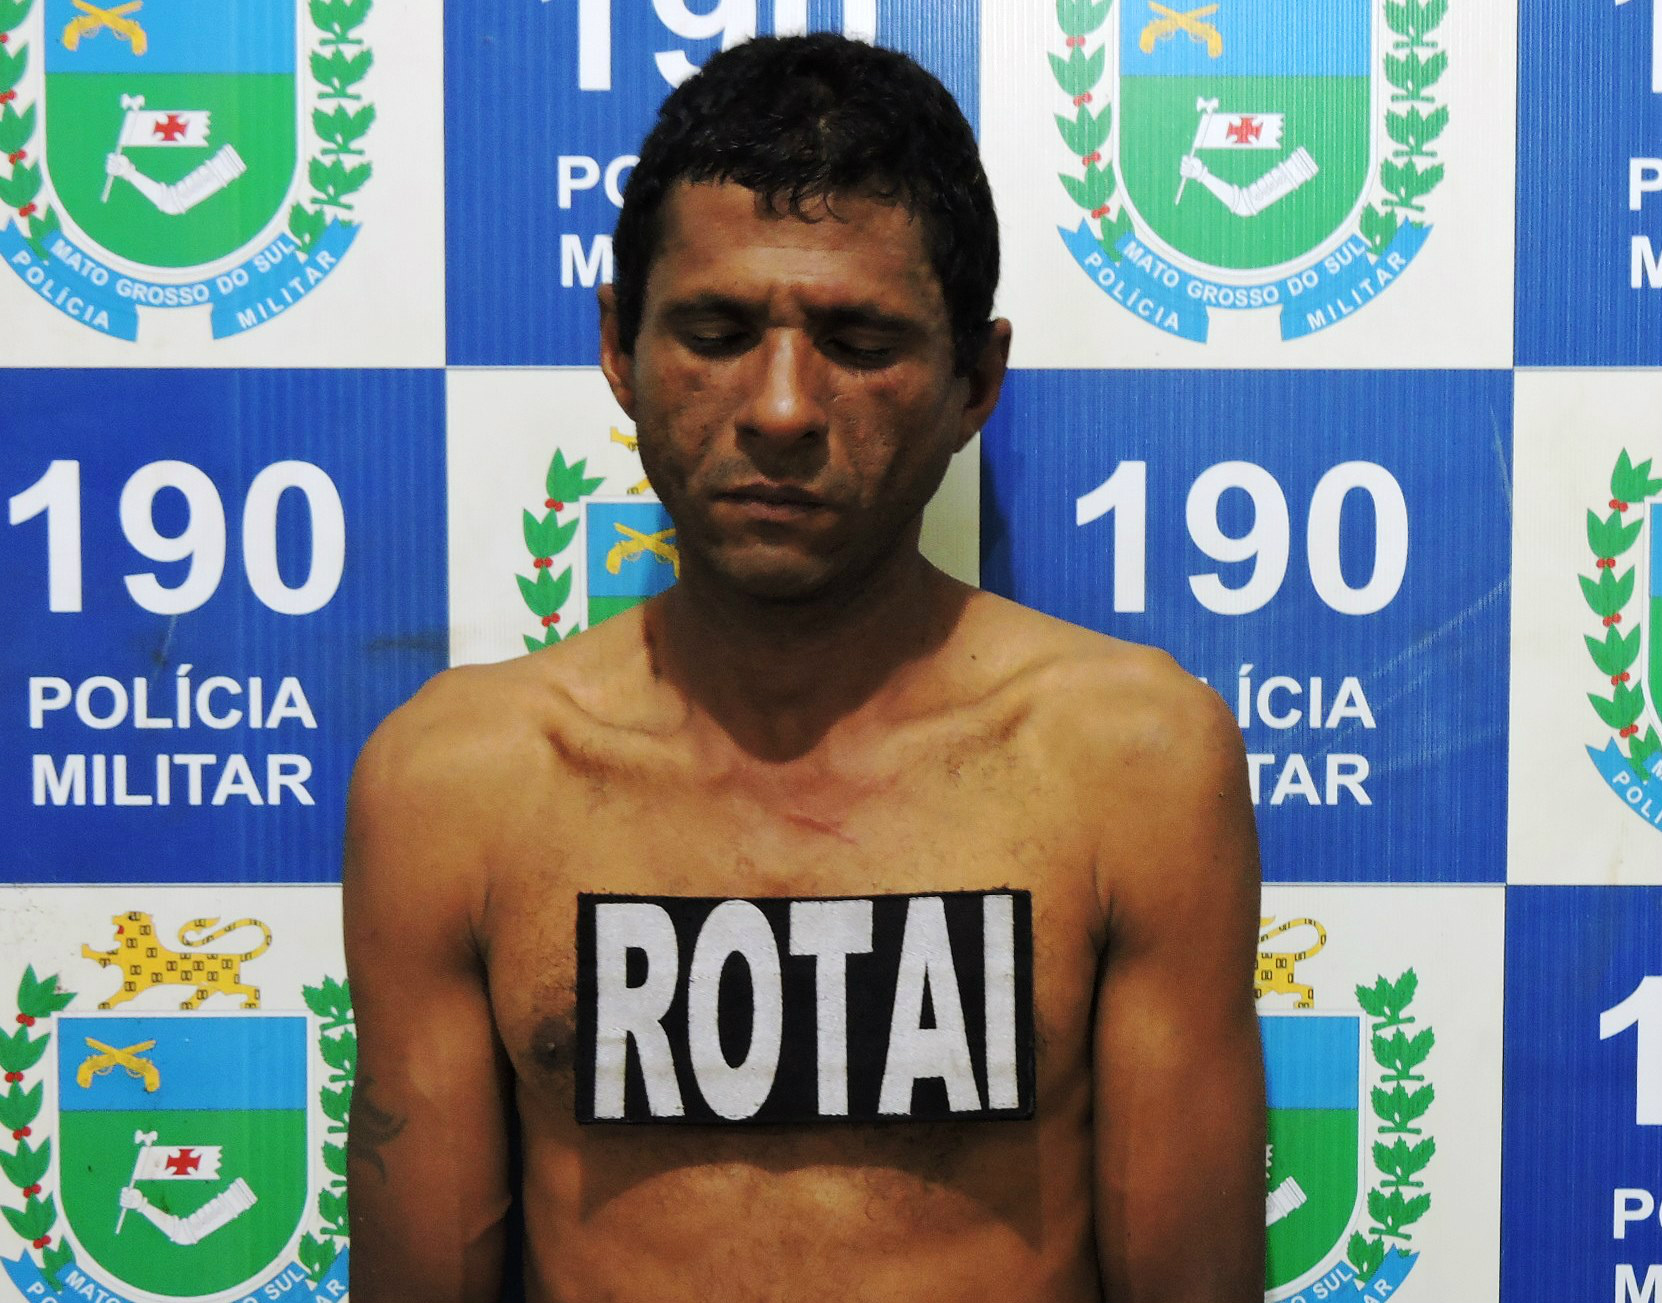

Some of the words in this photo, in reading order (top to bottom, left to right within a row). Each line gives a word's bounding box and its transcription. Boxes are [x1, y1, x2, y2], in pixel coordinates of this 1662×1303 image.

[11, 250, 109, 330] POLÍCIA
[236, 250, 337, 329] MILITAR
[51, 239, 109, 287] MATO
[115, 278, 210, 306] GROSSO
[216, 268, 249, 295] DO
[253, 240, 295, 273] SUL
[1084, 252, 1179, 331] POLÍCIA
[1306, 251, 1406, 330] MILITAR
[1124, 241, 1180, 288] MATO
[1187, 280, 1279, 307] GROSSO
[1287, 269, 1319, 297] DO
[1324, 239, 1366, 275] SUL
[9, 460, 346, 615] 190
[1076, 460, 1409, 615] 190
[29, 664, 318, 730] POLÍCIA
[1238, 664, 1377, 730] ÍCIA
[32, 754, 316, 806] MILITAR
[594, 894, 1018, 1120] ROTAI
[264, 1269, 305, 1300] SUL
[1312, 1268, 1353, 1300] SUL
